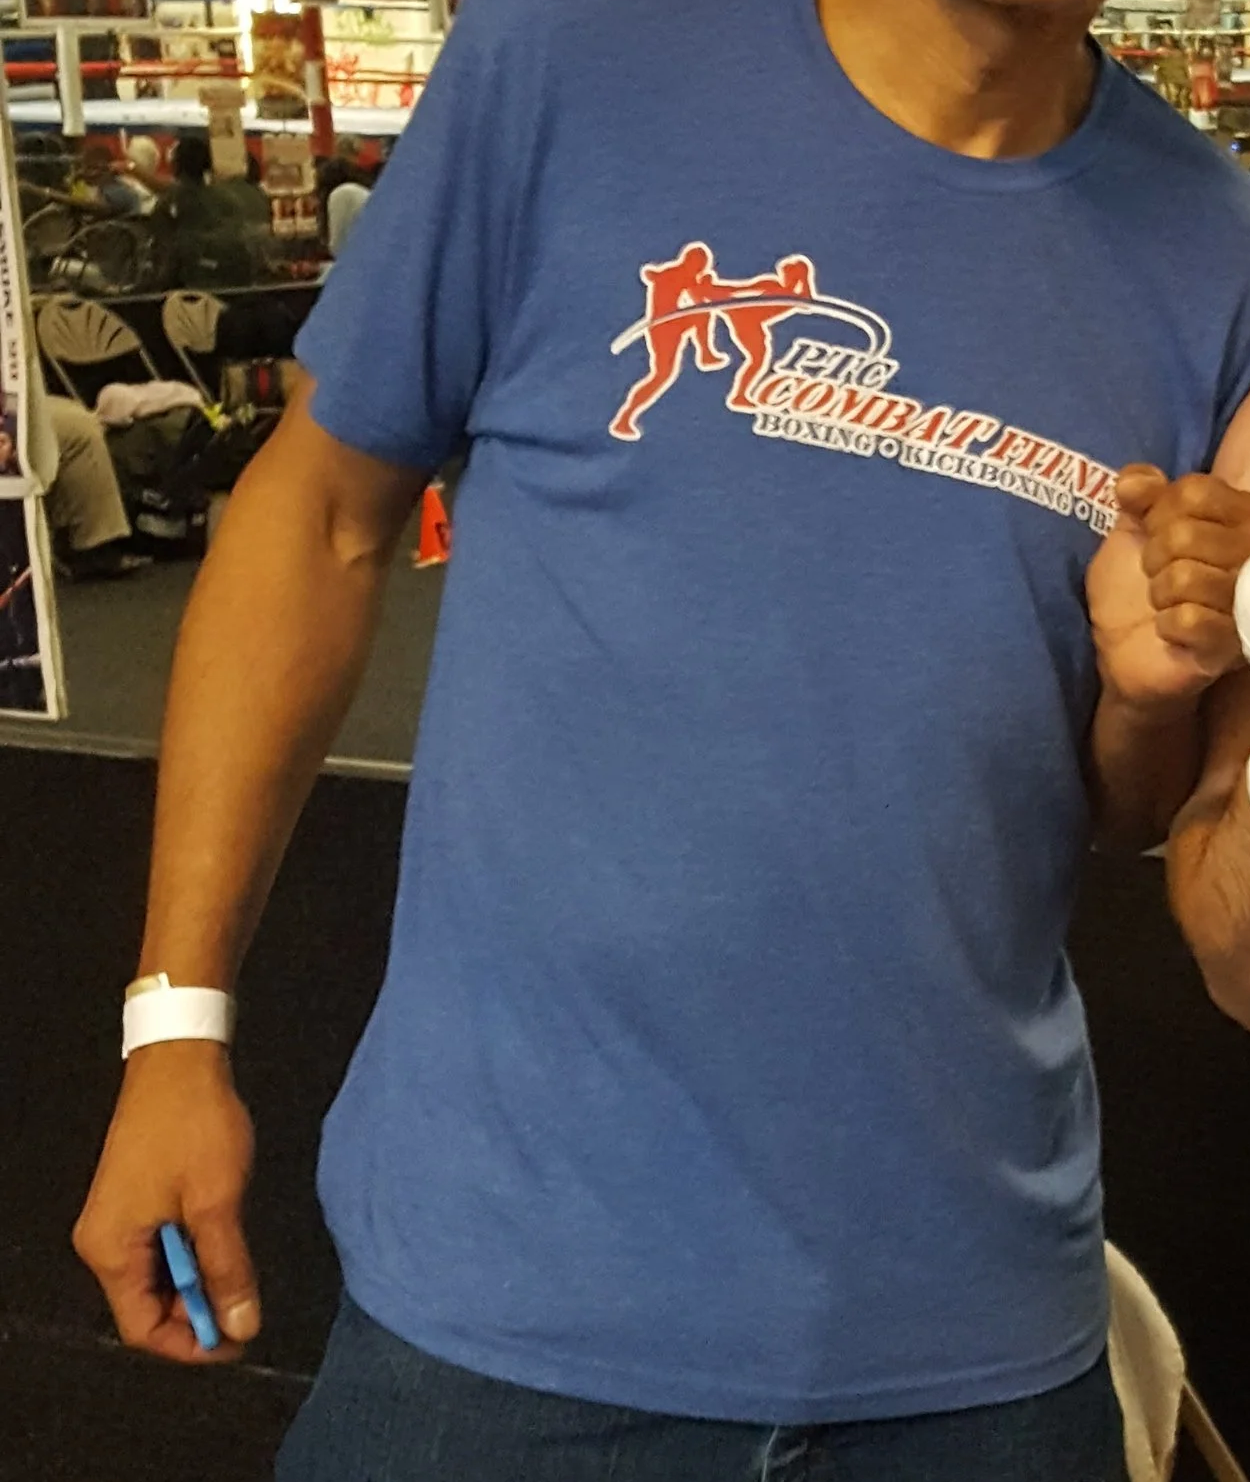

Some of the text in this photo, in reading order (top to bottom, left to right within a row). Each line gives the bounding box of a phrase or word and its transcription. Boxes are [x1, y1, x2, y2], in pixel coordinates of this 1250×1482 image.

[783, 342, 895, 388] PTC
[757, 375, 1122, 511] COMBAT FITNE
[758, 411, 1071, 512] BOXING KICKBOXING
